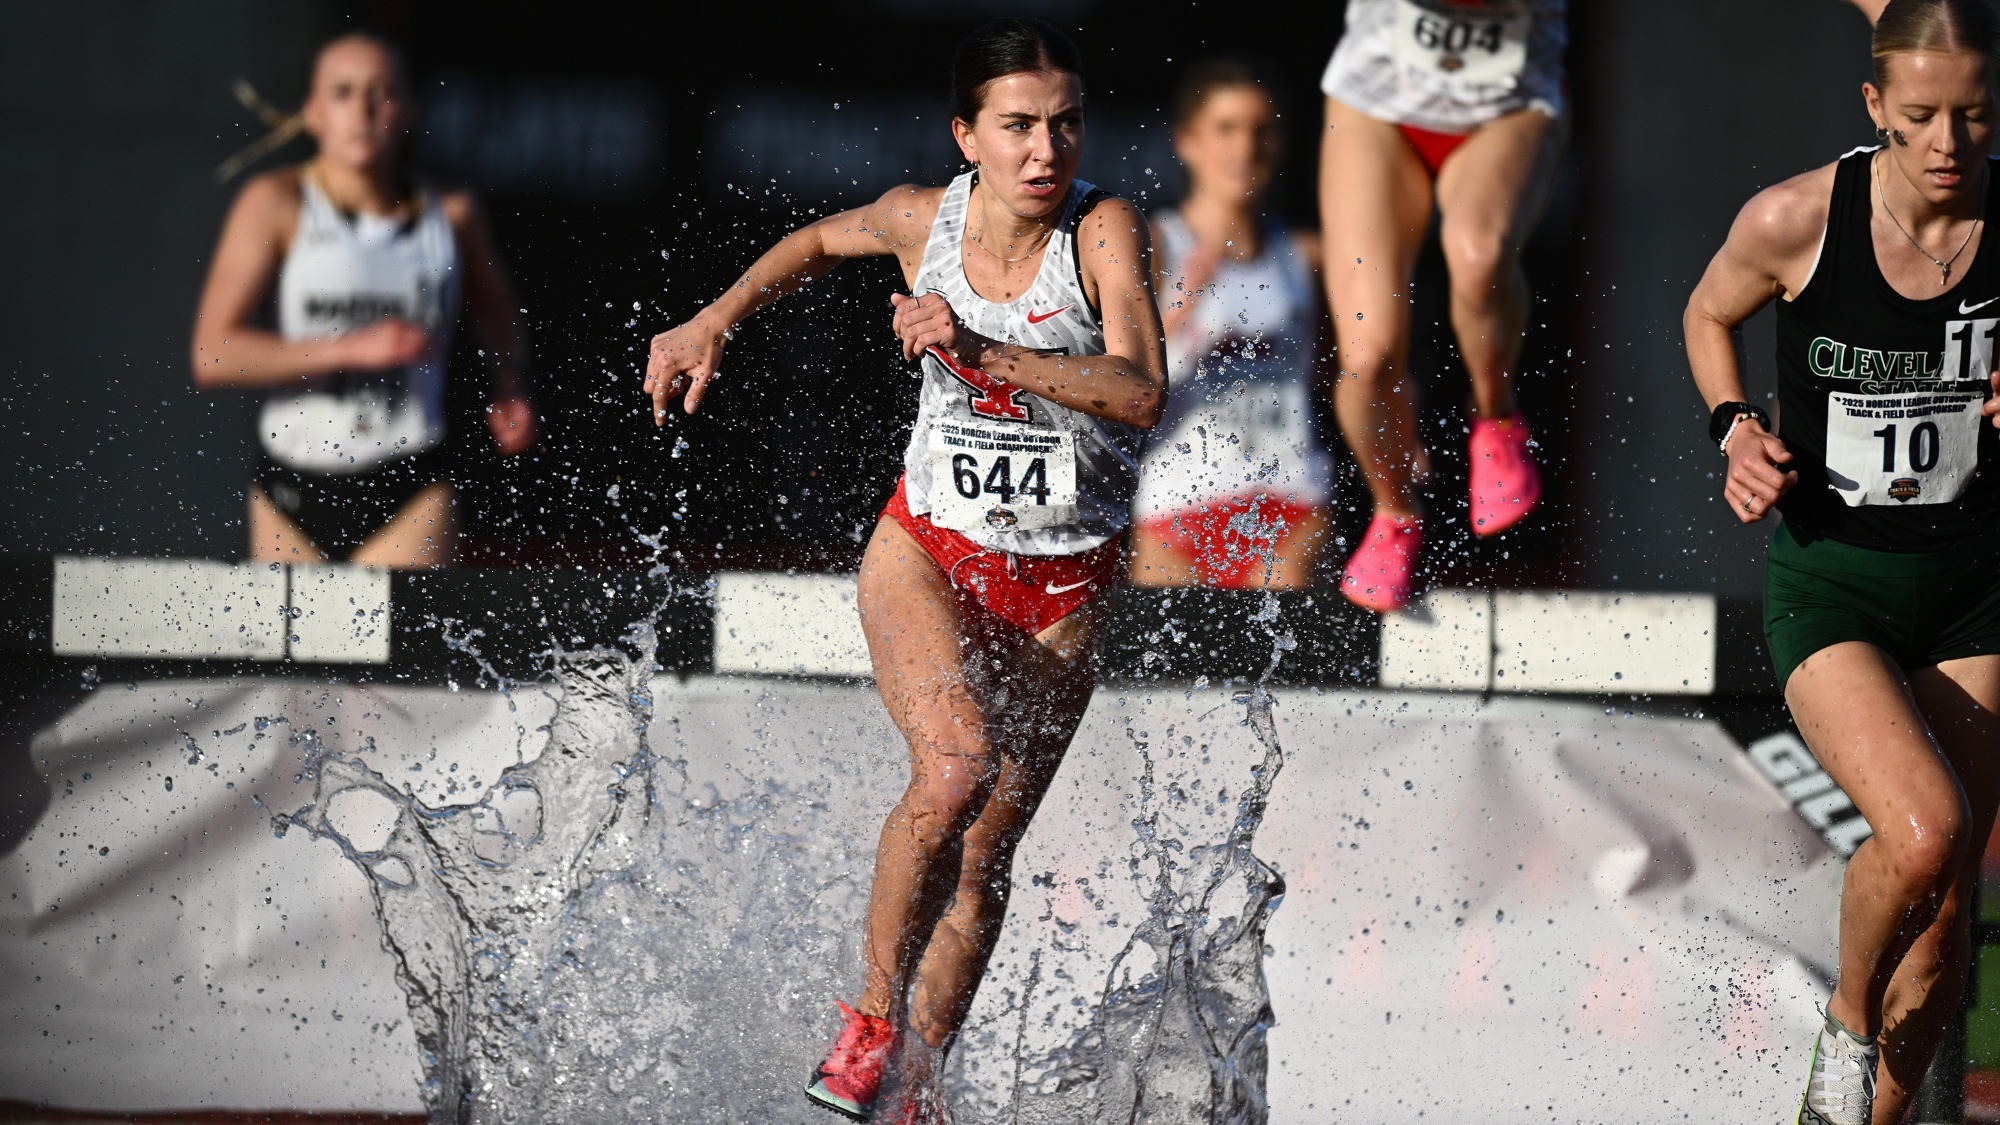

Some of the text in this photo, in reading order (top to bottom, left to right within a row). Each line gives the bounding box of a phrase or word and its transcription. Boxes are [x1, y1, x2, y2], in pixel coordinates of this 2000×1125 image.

[1414, 14, 1503, 54] 604
[1951, 320, 2000, 378] 11
[1842, 395, 1972, 408] 2025 HORIZON LEAGUE OUTDOOR
[1845, 408, 1873, 418] TRACK
[1883, 410, 1904, 418] FIELD
[1906, 404, 1967, 418] CHAMPIONSHIP
[944, 436, 966, 447] TRACK
[975, 441, 994, 450] FIELD
[961, 426, 991, 440] HORIZON
[993, 431, 1021, 442] LEAGUE
[1023, 434, 1061, 444] OUTDOOR
[1873, 421, 1940, 473] 10
[952, 453, 1052, 506] 644
